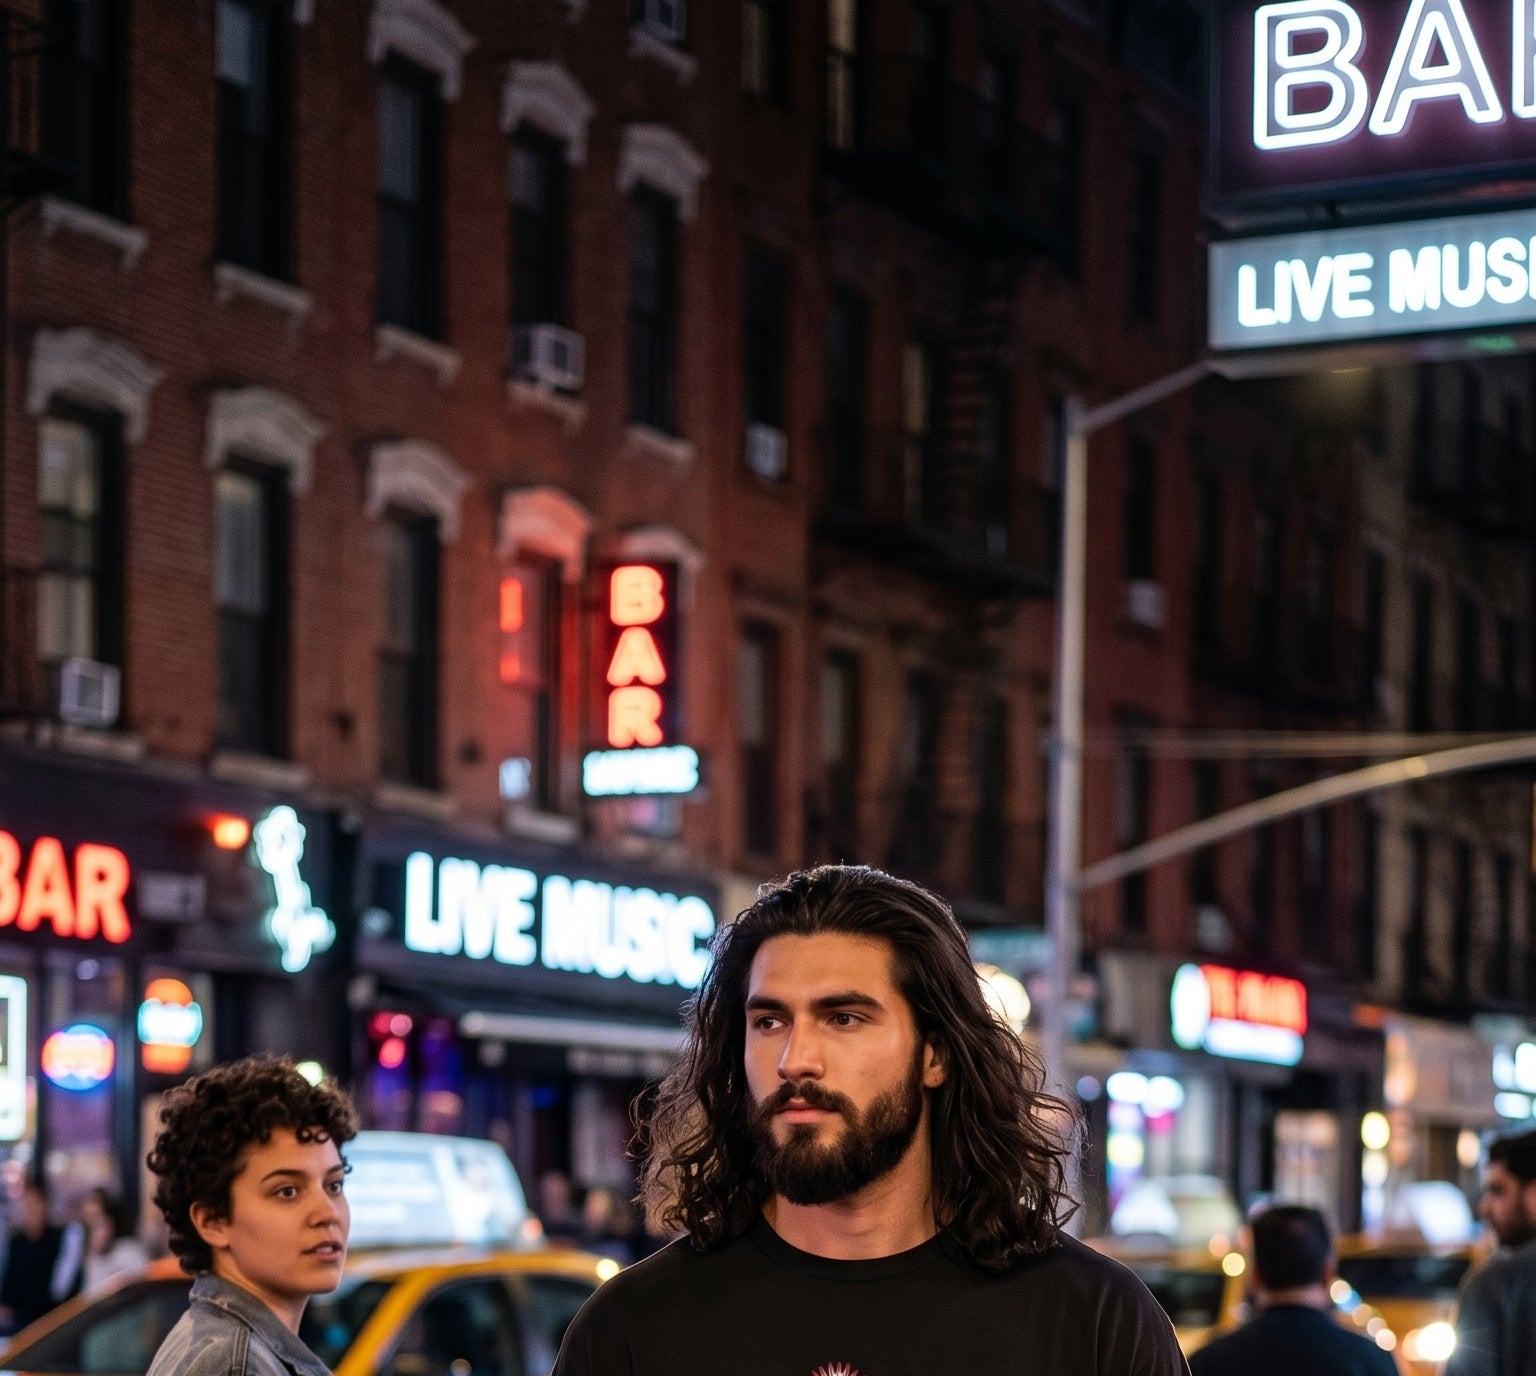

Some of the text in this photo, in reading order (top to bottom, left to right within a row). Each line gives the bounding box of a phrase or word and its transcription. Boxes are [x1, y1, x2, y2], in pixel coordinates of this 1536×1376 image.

[1238, 252, 1375, 328] LIVE
[607, 565, 666, 748] BAR
[405, 851, 715, 990] LIVE MUSIC
